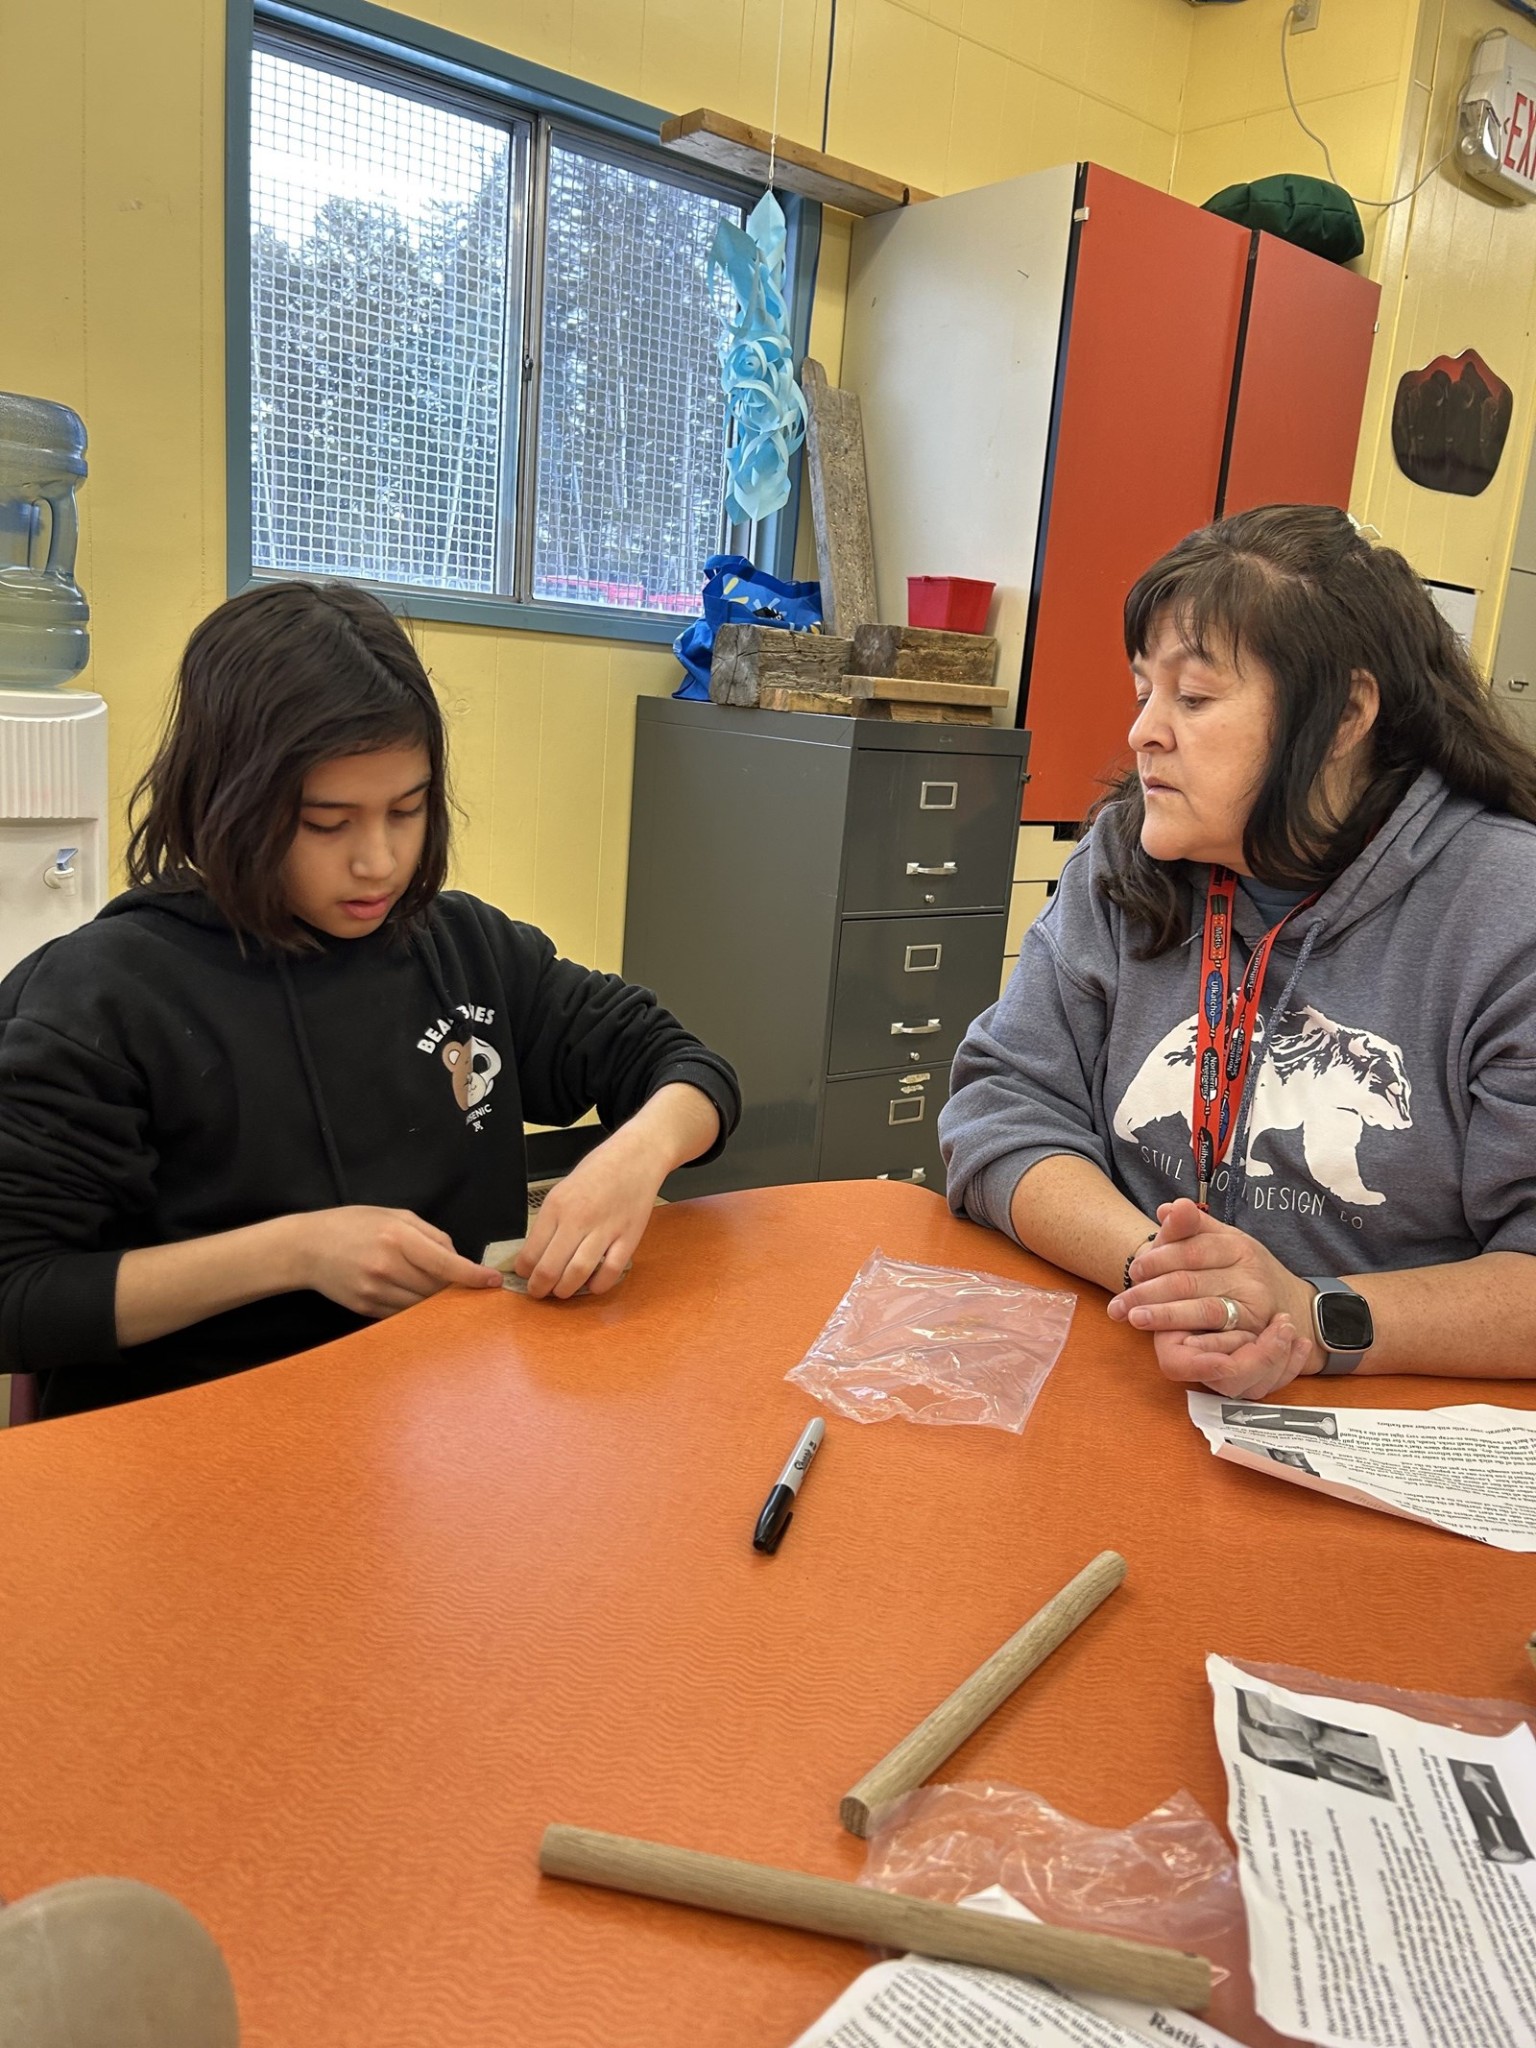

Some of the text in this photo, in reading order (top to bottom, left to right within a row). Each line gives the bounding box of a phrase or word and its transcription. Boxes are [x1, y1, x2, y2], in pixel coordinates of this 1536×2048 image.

[1209, 980, 1219, 1017] Ulkatcho
[1203, 1052, 1211, 1096] Secwepemc
[1209, 1056, 1218, 1091] Northern
[1141, 1146, 1183, 1181] STILL
[1254, 1186, 1326, 1217] DESIGN
